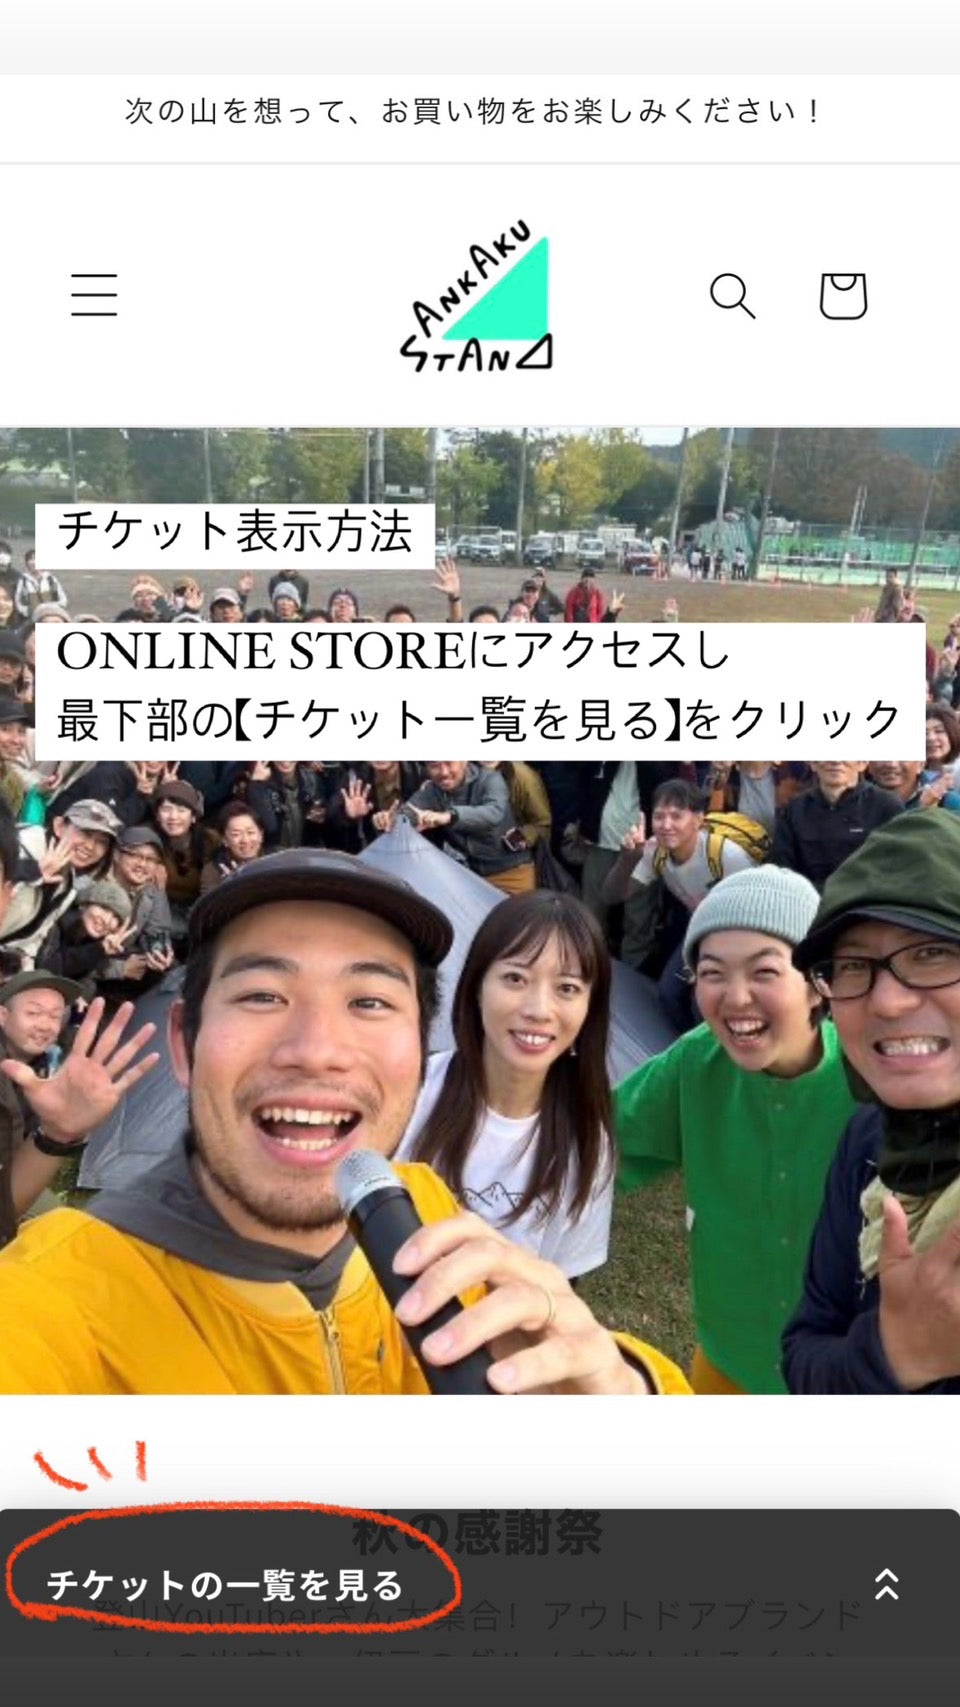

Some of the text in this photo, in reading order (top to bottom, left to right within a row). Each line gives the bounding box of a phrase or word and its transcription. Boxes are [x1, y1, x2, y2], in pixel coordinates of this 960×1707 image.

[351, 1509, 604, 1557] 秋の感謝祭
[46, 1568, 403, 1602] チケットの一覧を見る
